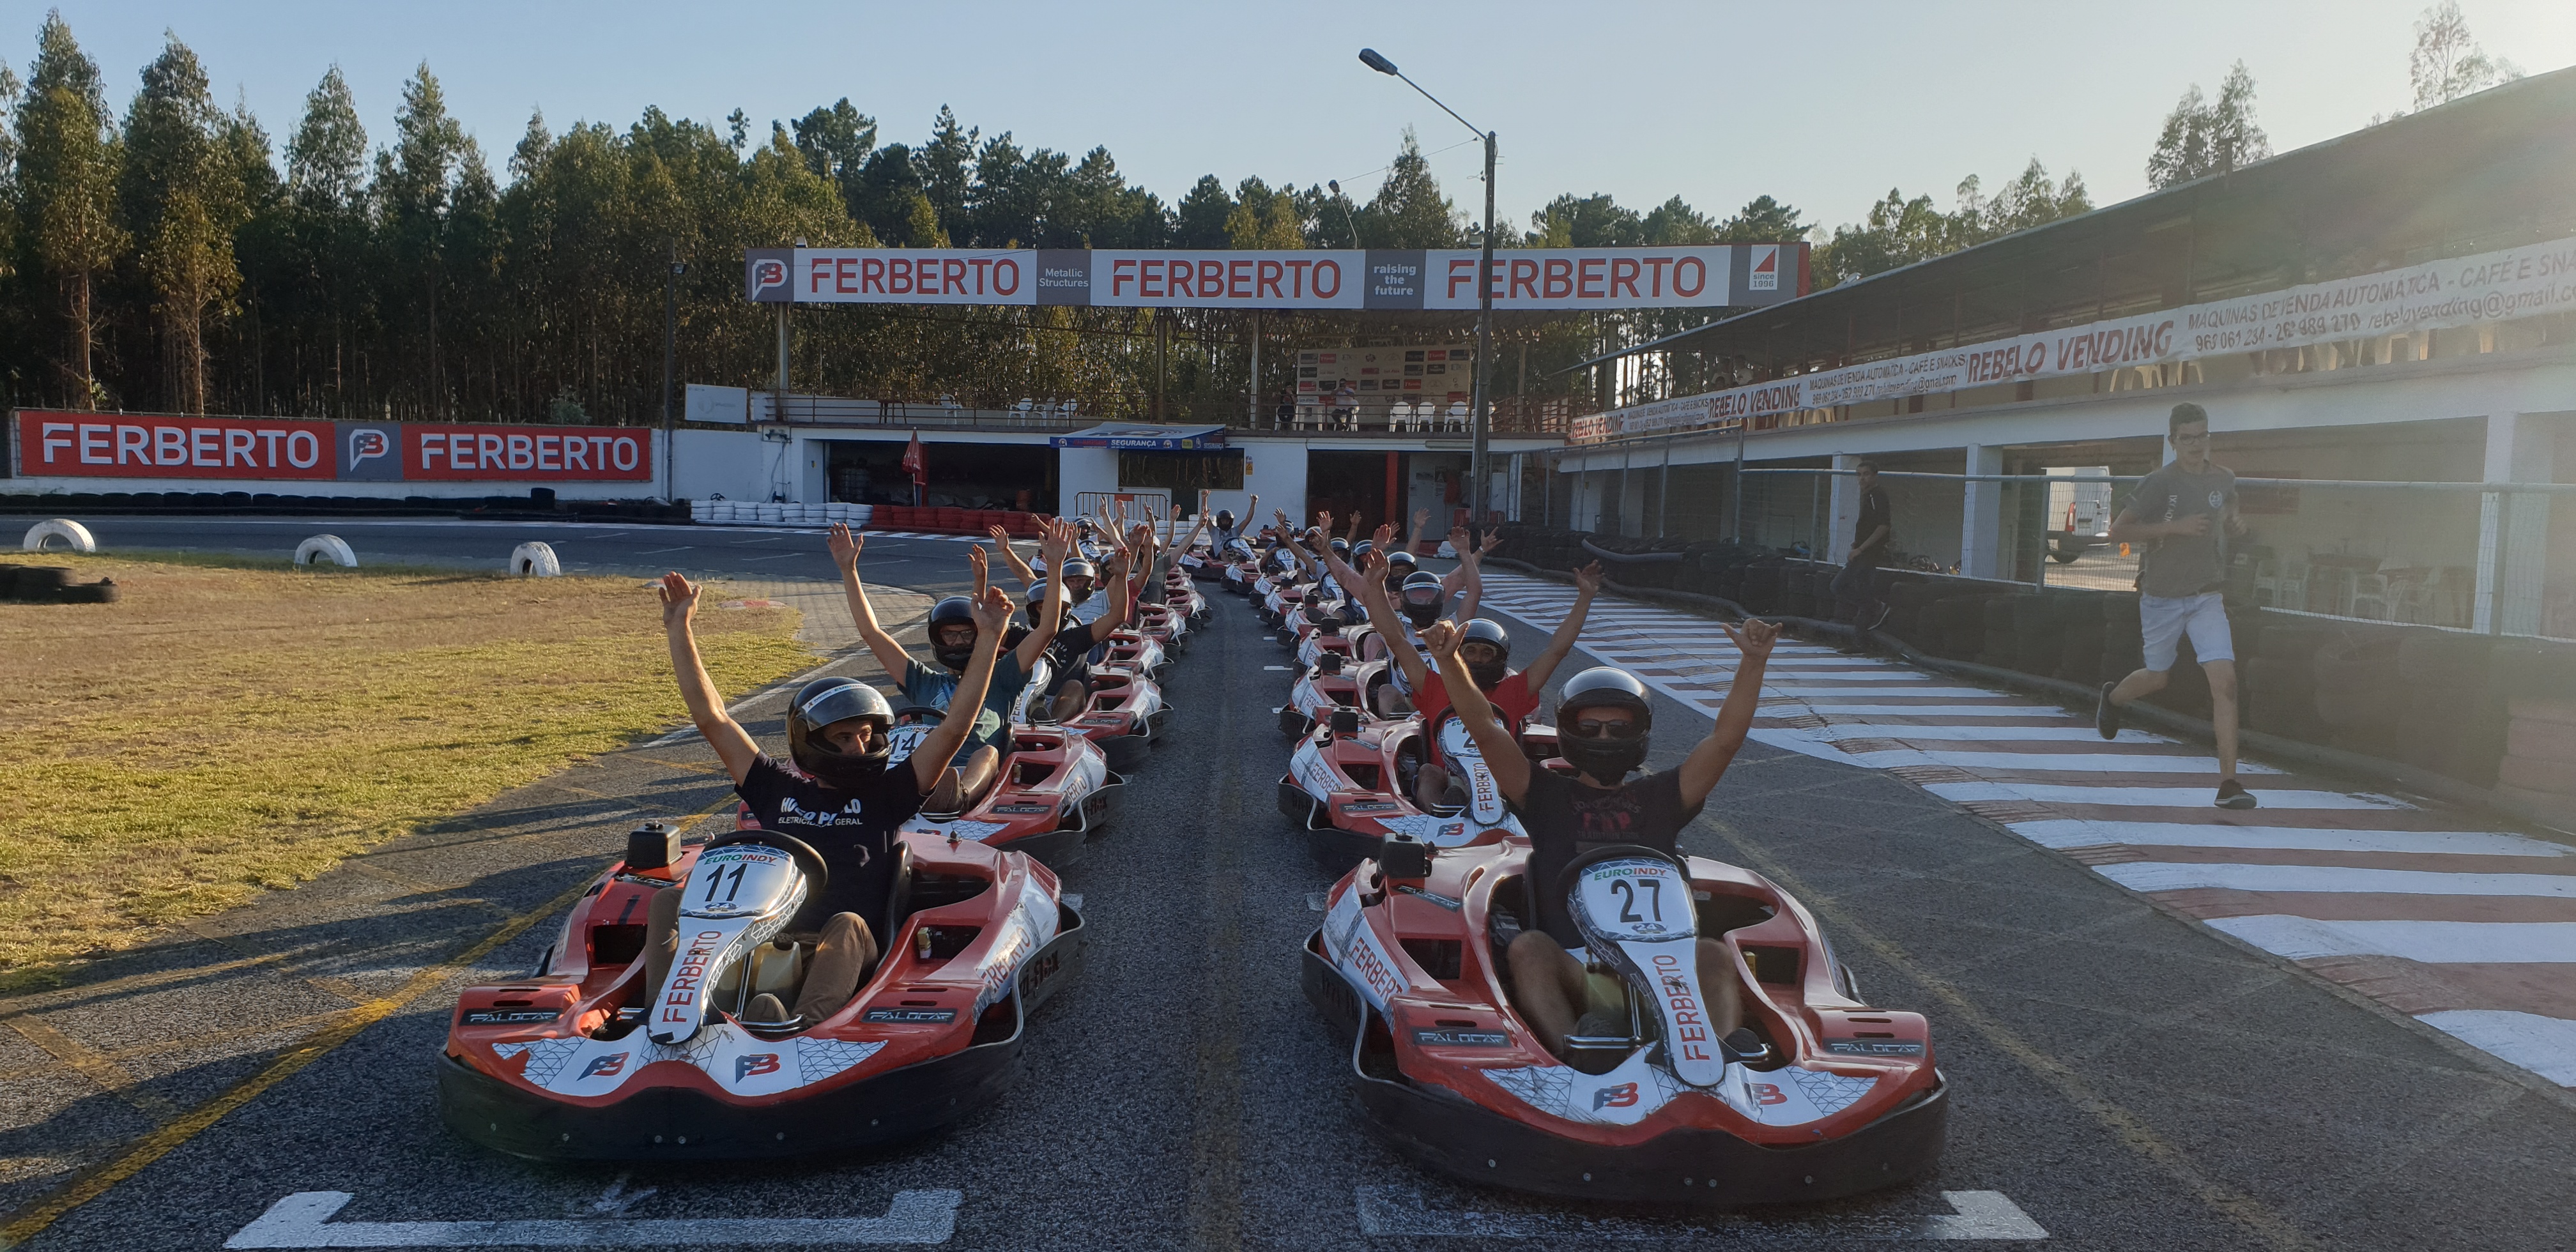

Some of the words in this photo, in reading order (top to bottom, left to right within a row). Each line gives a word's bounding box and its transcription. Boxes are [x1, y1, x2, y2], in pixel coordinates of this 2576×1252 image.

[811, 258, 1020, 296] FERBERTO
[1039, 277, 1089, 288] Structures
[1045, 267, 1084, 279] Metallic
[1113, 259, 1341, 298] FERBERTO
[1374, 263, 1417, 277] raising
[1384, 275, 1405, 285] the
[1448, 256, 1706, 299] FERBERTO
[1374, 285, 1414, 296] future
[2188, 304, 2258, 330] MÁQUINAS
[2460, 256, 2513, 287] CAFÉ
[2517, 259, 2533, 280] E
[1909, 356, 1928, 374] CAFÉ
[1929, 359, 1935, 372] E
[1968, 342, 2046, 383] REBELO
[2057, 319, 2174, 372] VENDING
[1709, 393, 1747, 418] REBELO
[1750, 383, 1801, 413] VENDING
[43, 422, 319, 468] FERBERTO
[421, 432, 639, 471] FERBERTO
[889, 727, 929, 735] EUROIND
[890, 733, 917, 754] 14
[835, 818, 863, 826] GERAL
[704, 854, 778, 865] EUROINDY
[1594, 867, 1667, 881] EUROINDY
[705, 863, 748, 902] 11
[1610, 879, 1662, 922] 27
[662, 930, 722, 1023] FERBERTO
[1652, 954, 1710, 1060] FERBERTO
